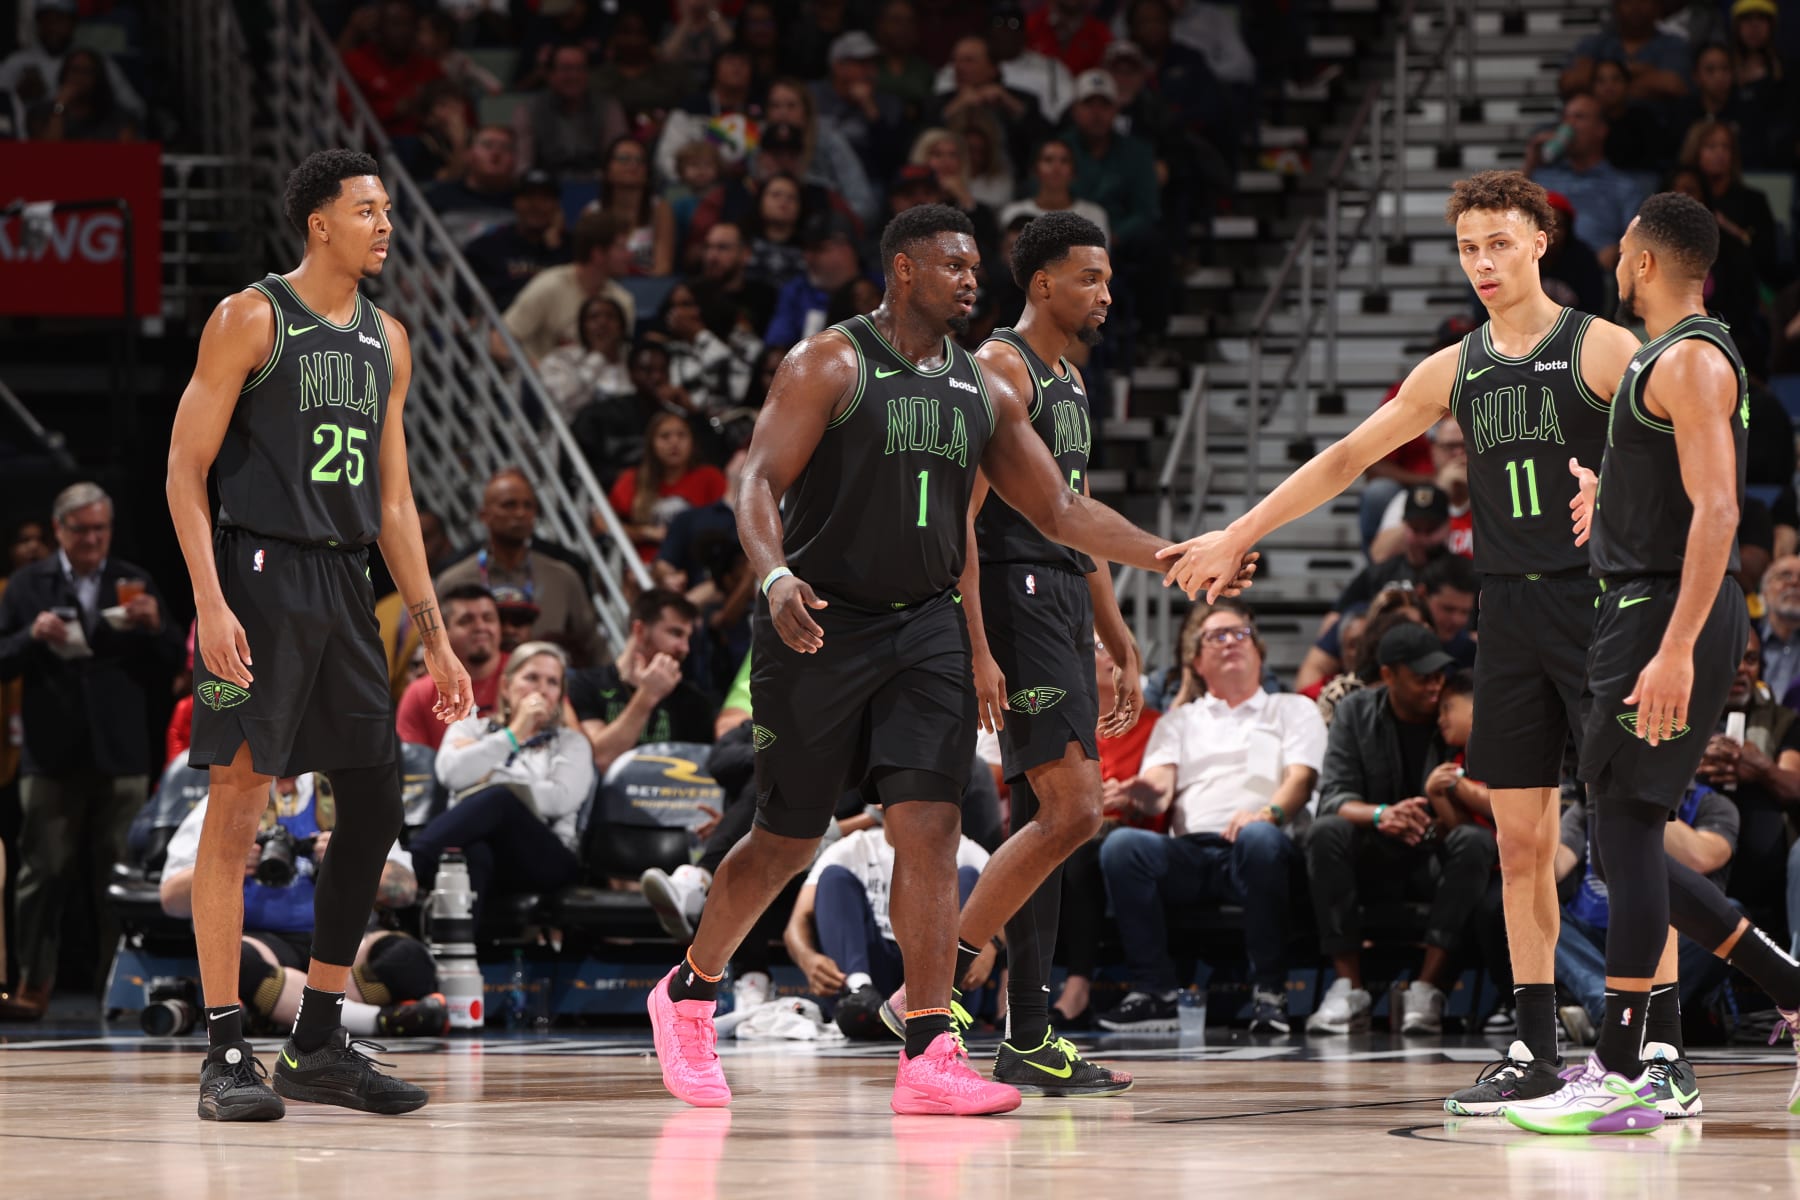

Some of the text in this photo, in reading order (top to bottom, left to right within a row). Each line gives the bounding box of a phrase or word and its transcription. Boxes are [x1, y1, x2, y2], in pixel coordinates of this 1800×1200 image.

[0, 212, 122, 262] NG
[358, 332, 381, 349] ibotta
[1534, 360, 1568, 372] ibotta
[299, 351, 378, 424] NOLA
[948, 377, 978, 394] ibotta
[884, 396, 968, 468] NOLA
[1052, 400, 1091, 462] NOLA
[1472, 385, 1566, 454] NOLA
[311, 424, 367, 486] 25
[917, 470, 928, 527] 1
[1505, 458, 1541, 518] 11
